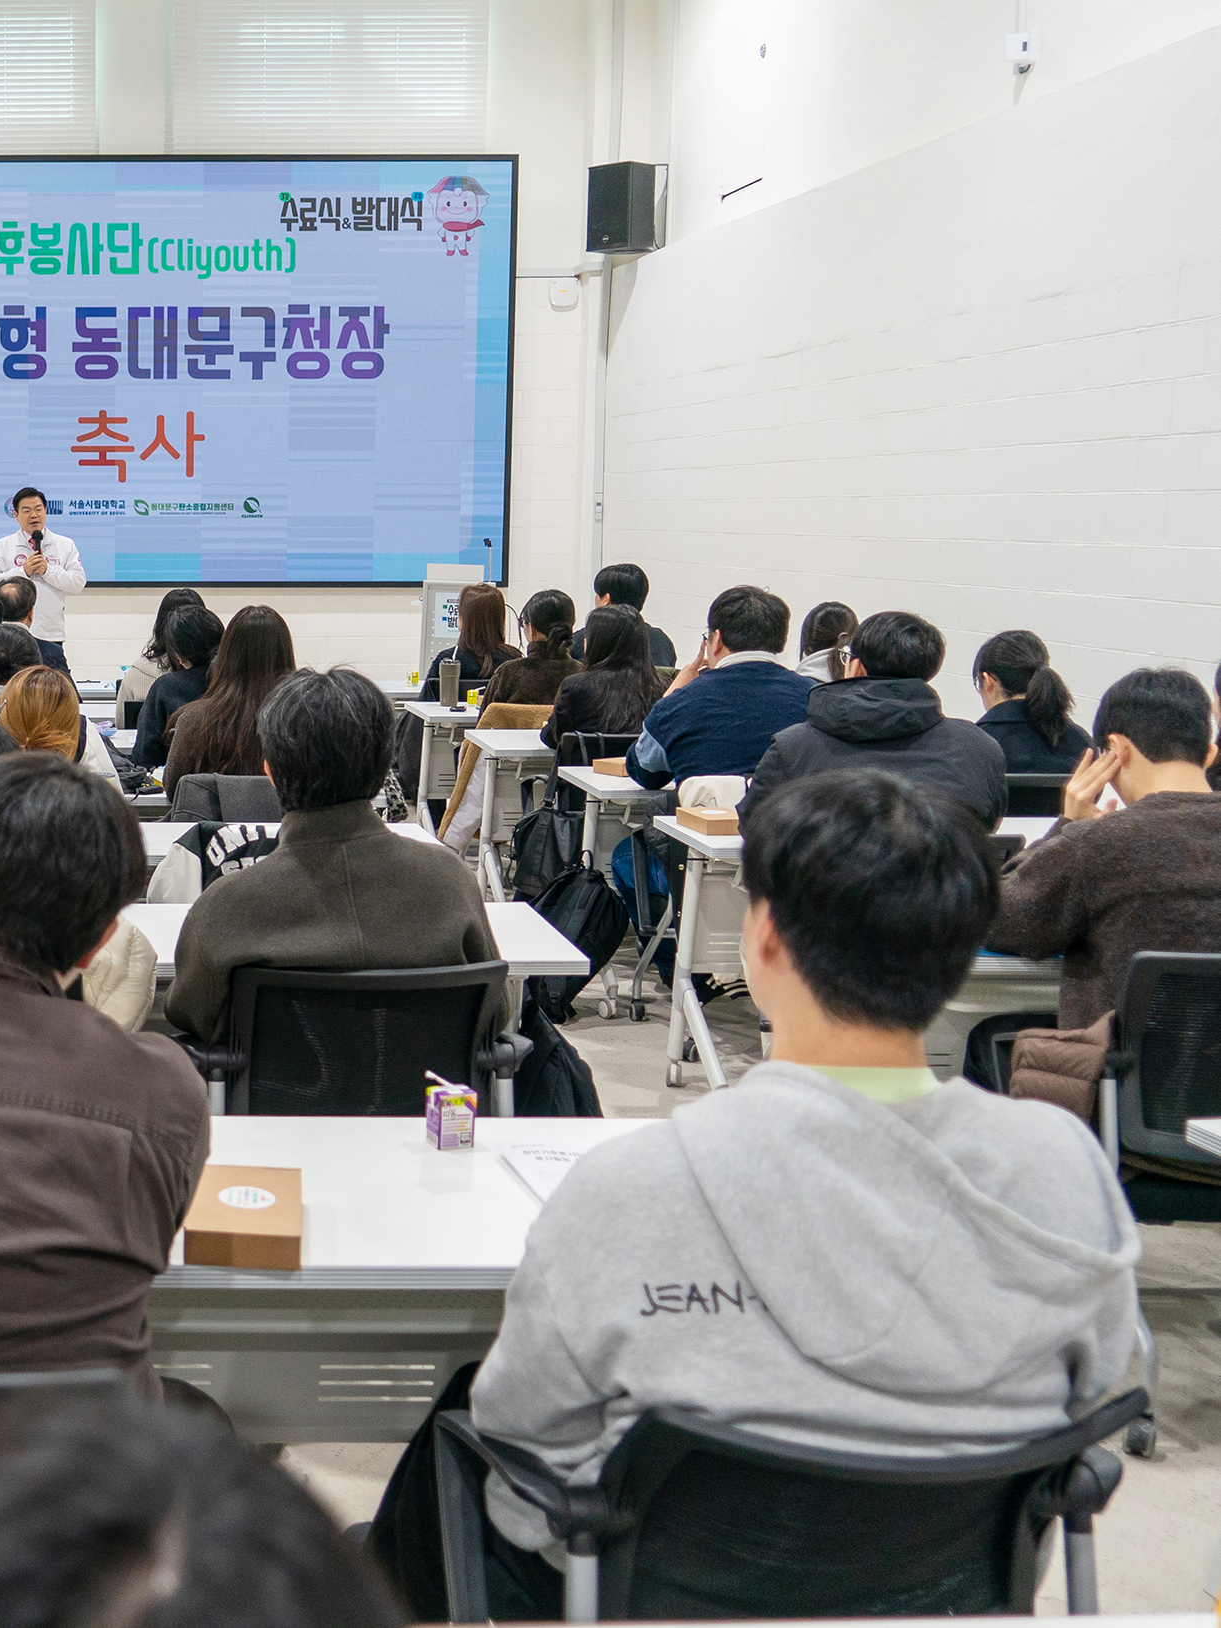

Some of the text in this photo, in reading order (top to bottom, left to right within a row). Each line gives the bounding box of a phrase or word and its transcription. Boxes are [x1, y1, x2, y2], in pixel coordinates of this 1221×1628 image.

[70, 304, 391, 381] 동대문구청장
[70, 409, 206, 483] 축사
[68, 499, 126, 509] 서울시립대학교
